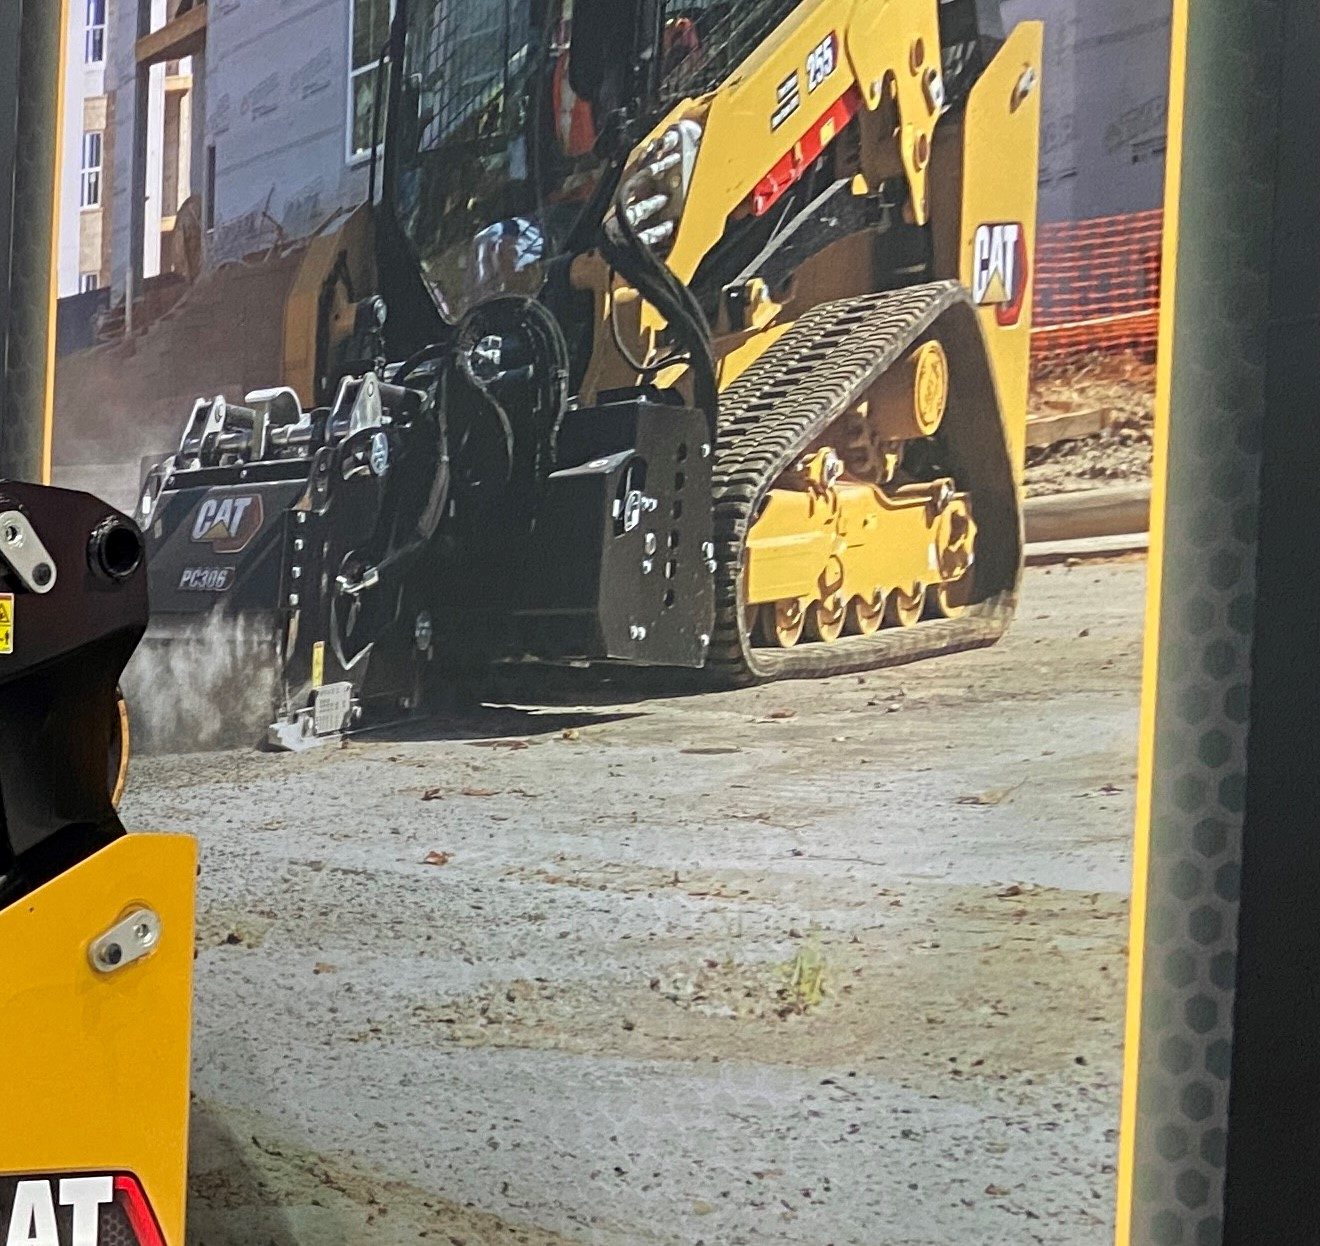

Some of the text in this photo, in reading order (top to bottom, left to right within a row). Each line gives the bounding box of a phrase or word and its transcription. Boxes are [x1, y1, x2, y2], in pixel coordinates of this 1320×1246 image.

[806, 35, 833, 92] 255
[972, 225, 1019, 304] CAT
[191, 497, 253, 539] CAT
[180, 569, 228, 589] PC306
